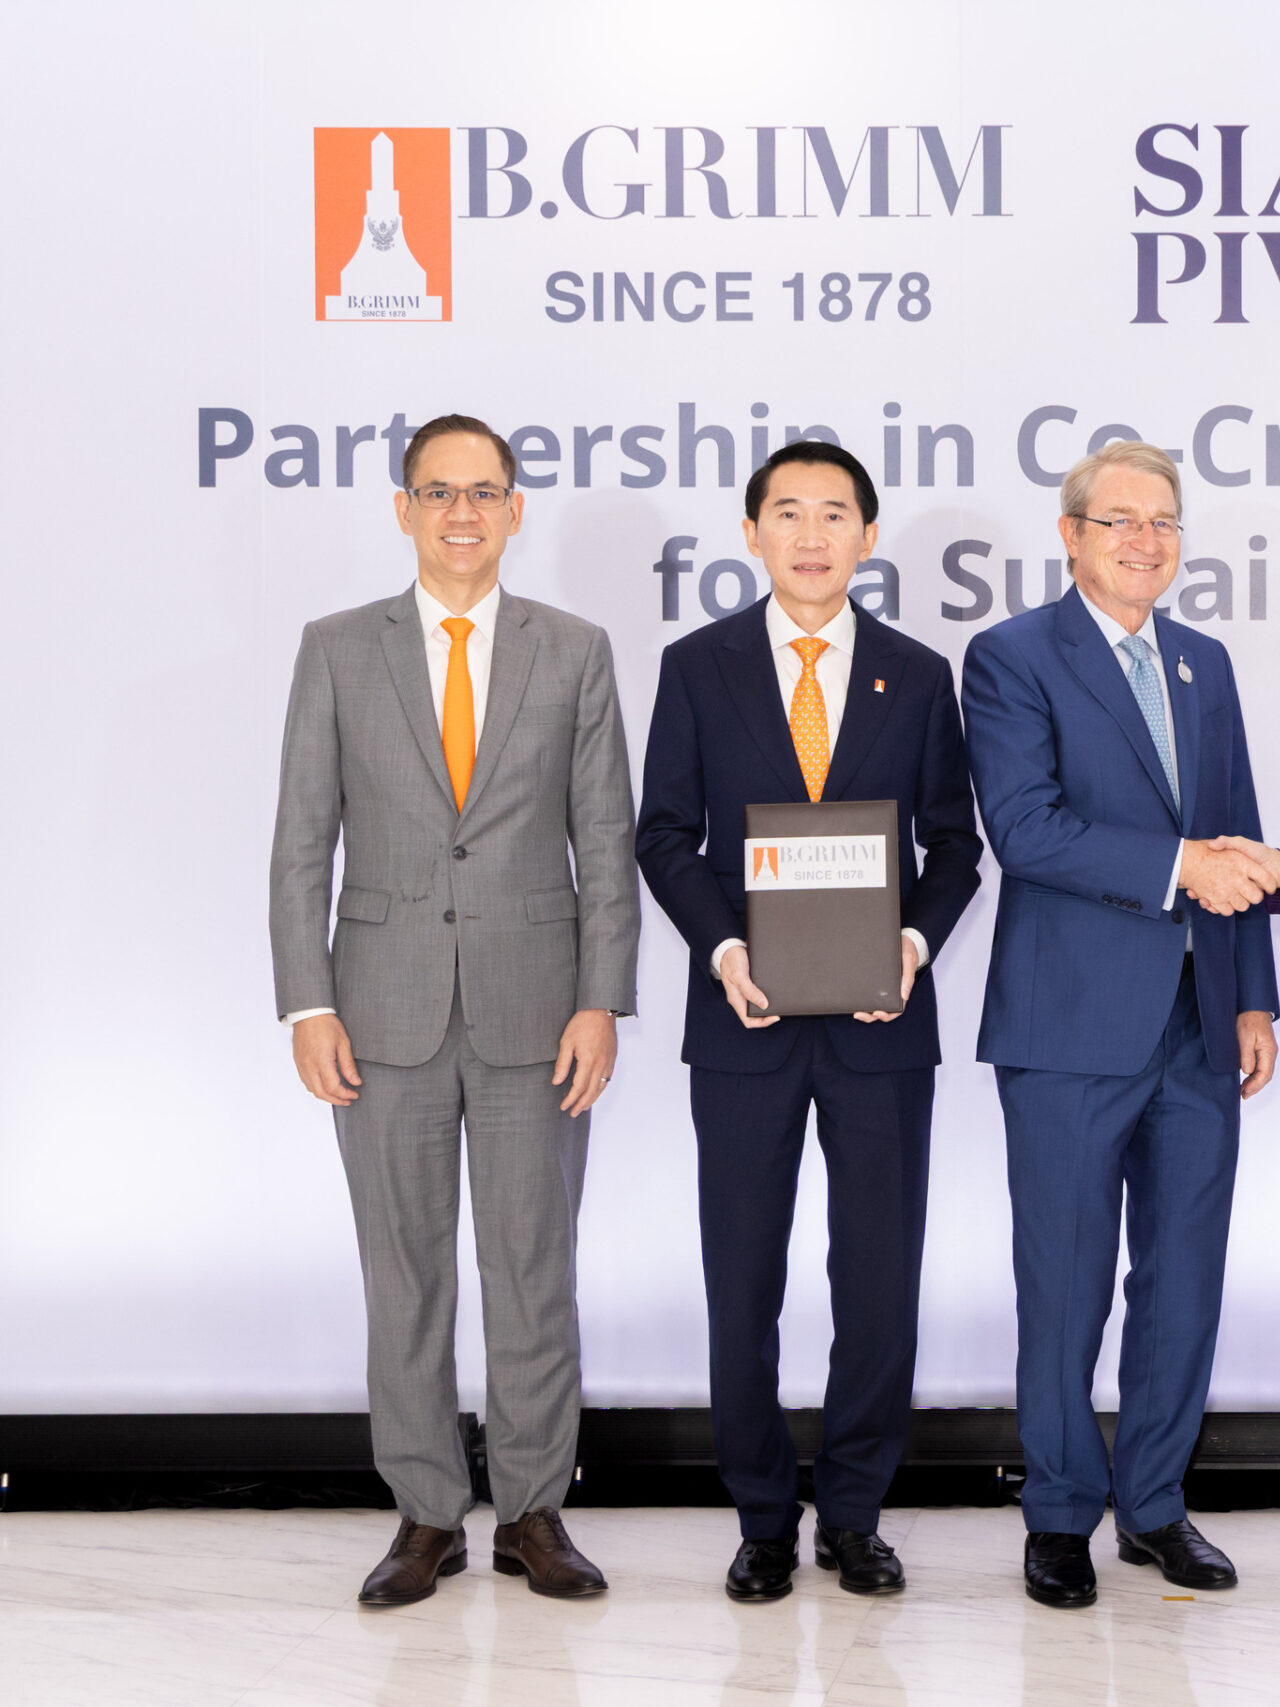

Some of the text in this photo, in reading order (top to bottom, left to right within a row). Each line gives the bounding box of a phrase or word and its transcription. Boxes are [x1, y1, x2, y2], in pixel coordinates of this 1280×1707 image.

[457, 125, 1014, 220] B.GRIMM
[348, 295, 419, 308] B.GRIMM
[361, 310, 407, 318] SINCE 1878
[544, 271, 932, 323] SINCE 1878
[198, 401, 842, 489] Partershi
[883, 401, 974, 487] in
[653, 535, 774, 622] fo
[849, 558, 899, 621] a
[781, 844, 877, 863] B.GRIMM
[794, 870, 865, 881] SINCE 1878
